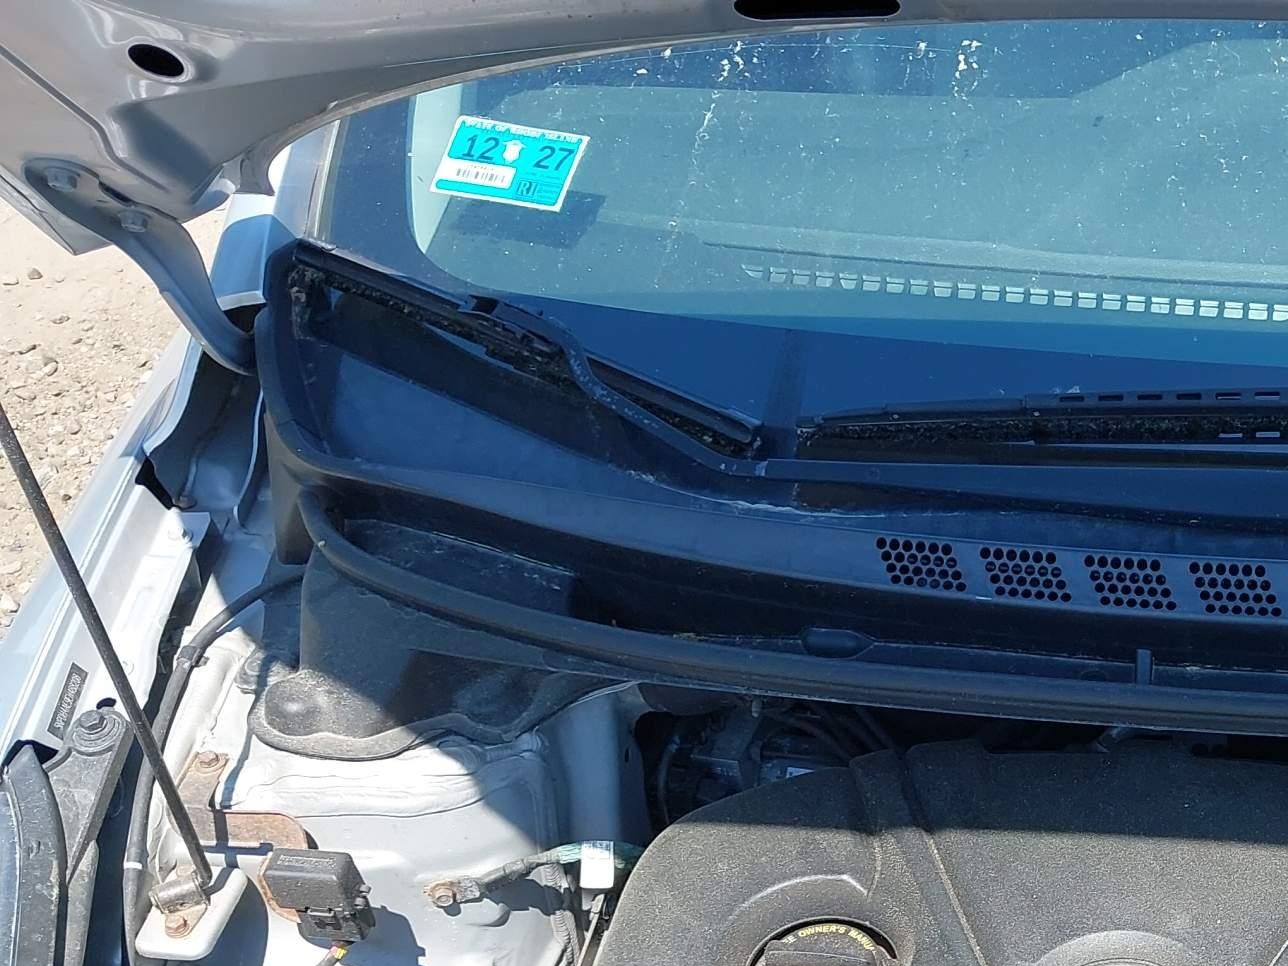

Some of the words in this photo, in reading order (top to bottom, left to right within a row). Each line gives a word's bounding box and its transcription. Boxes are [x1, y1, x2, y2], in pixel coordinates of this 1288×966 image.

[462, 133, 500, 161] 12
[533, 145, 575, 171] 27
[798, 924, 847, 938] OWNER'S
